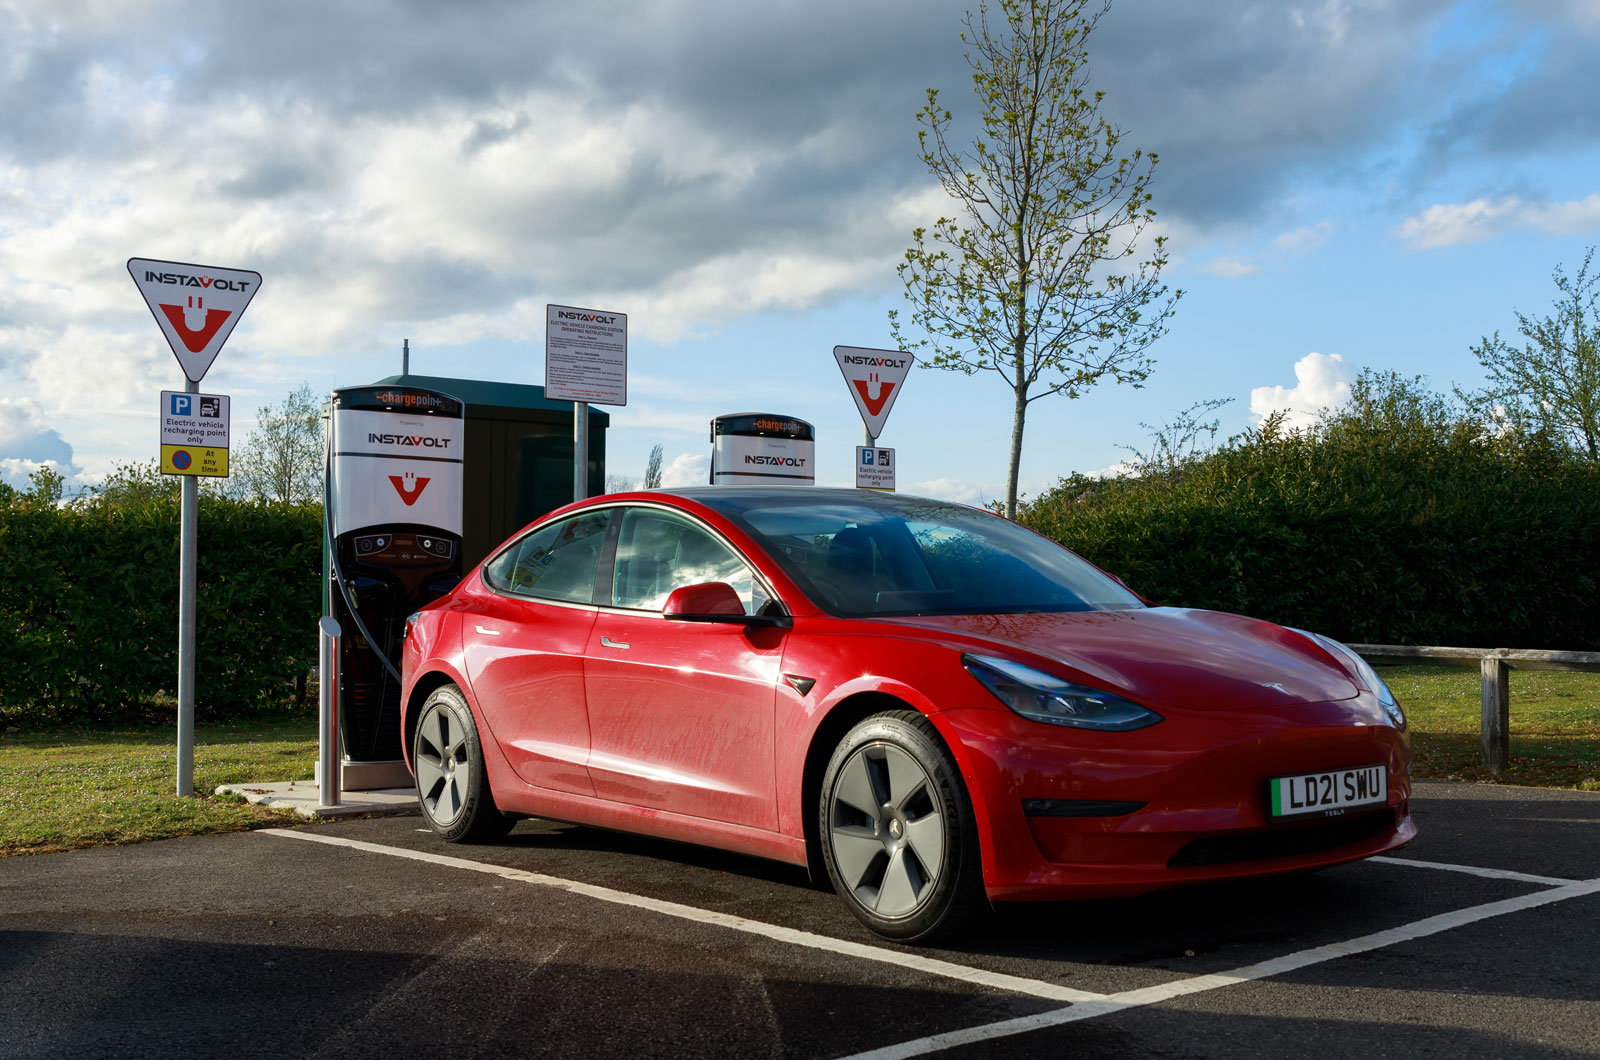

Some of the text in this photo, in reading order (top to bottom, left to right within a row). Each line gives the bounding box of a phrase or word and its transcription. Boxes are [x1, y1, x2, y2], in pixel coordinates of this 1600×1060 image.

[145, 271, 250, 292] INSTAVOLT
[558, 311, 616, 324] INSTAVOLT
[585, 329, 614, 337] INSTRUCTIONS
[844, 355, 906, 368] INSTAVOLT
[176, 397, 188, 414] P
[166, 418, 224, 429] Electric vehicle
[164, 427, 226, 437] recharging point
[188, 436, 204, 444] only
[368, 433, 451, 449] INSTAVOLT
[744, 455, 806, 467] INSTAVOLT
[865, 450, 872, 464] P
[1290, 768, 1380, 809] LD21 SWU
[1324, 808, 1344, 816] TESLA
